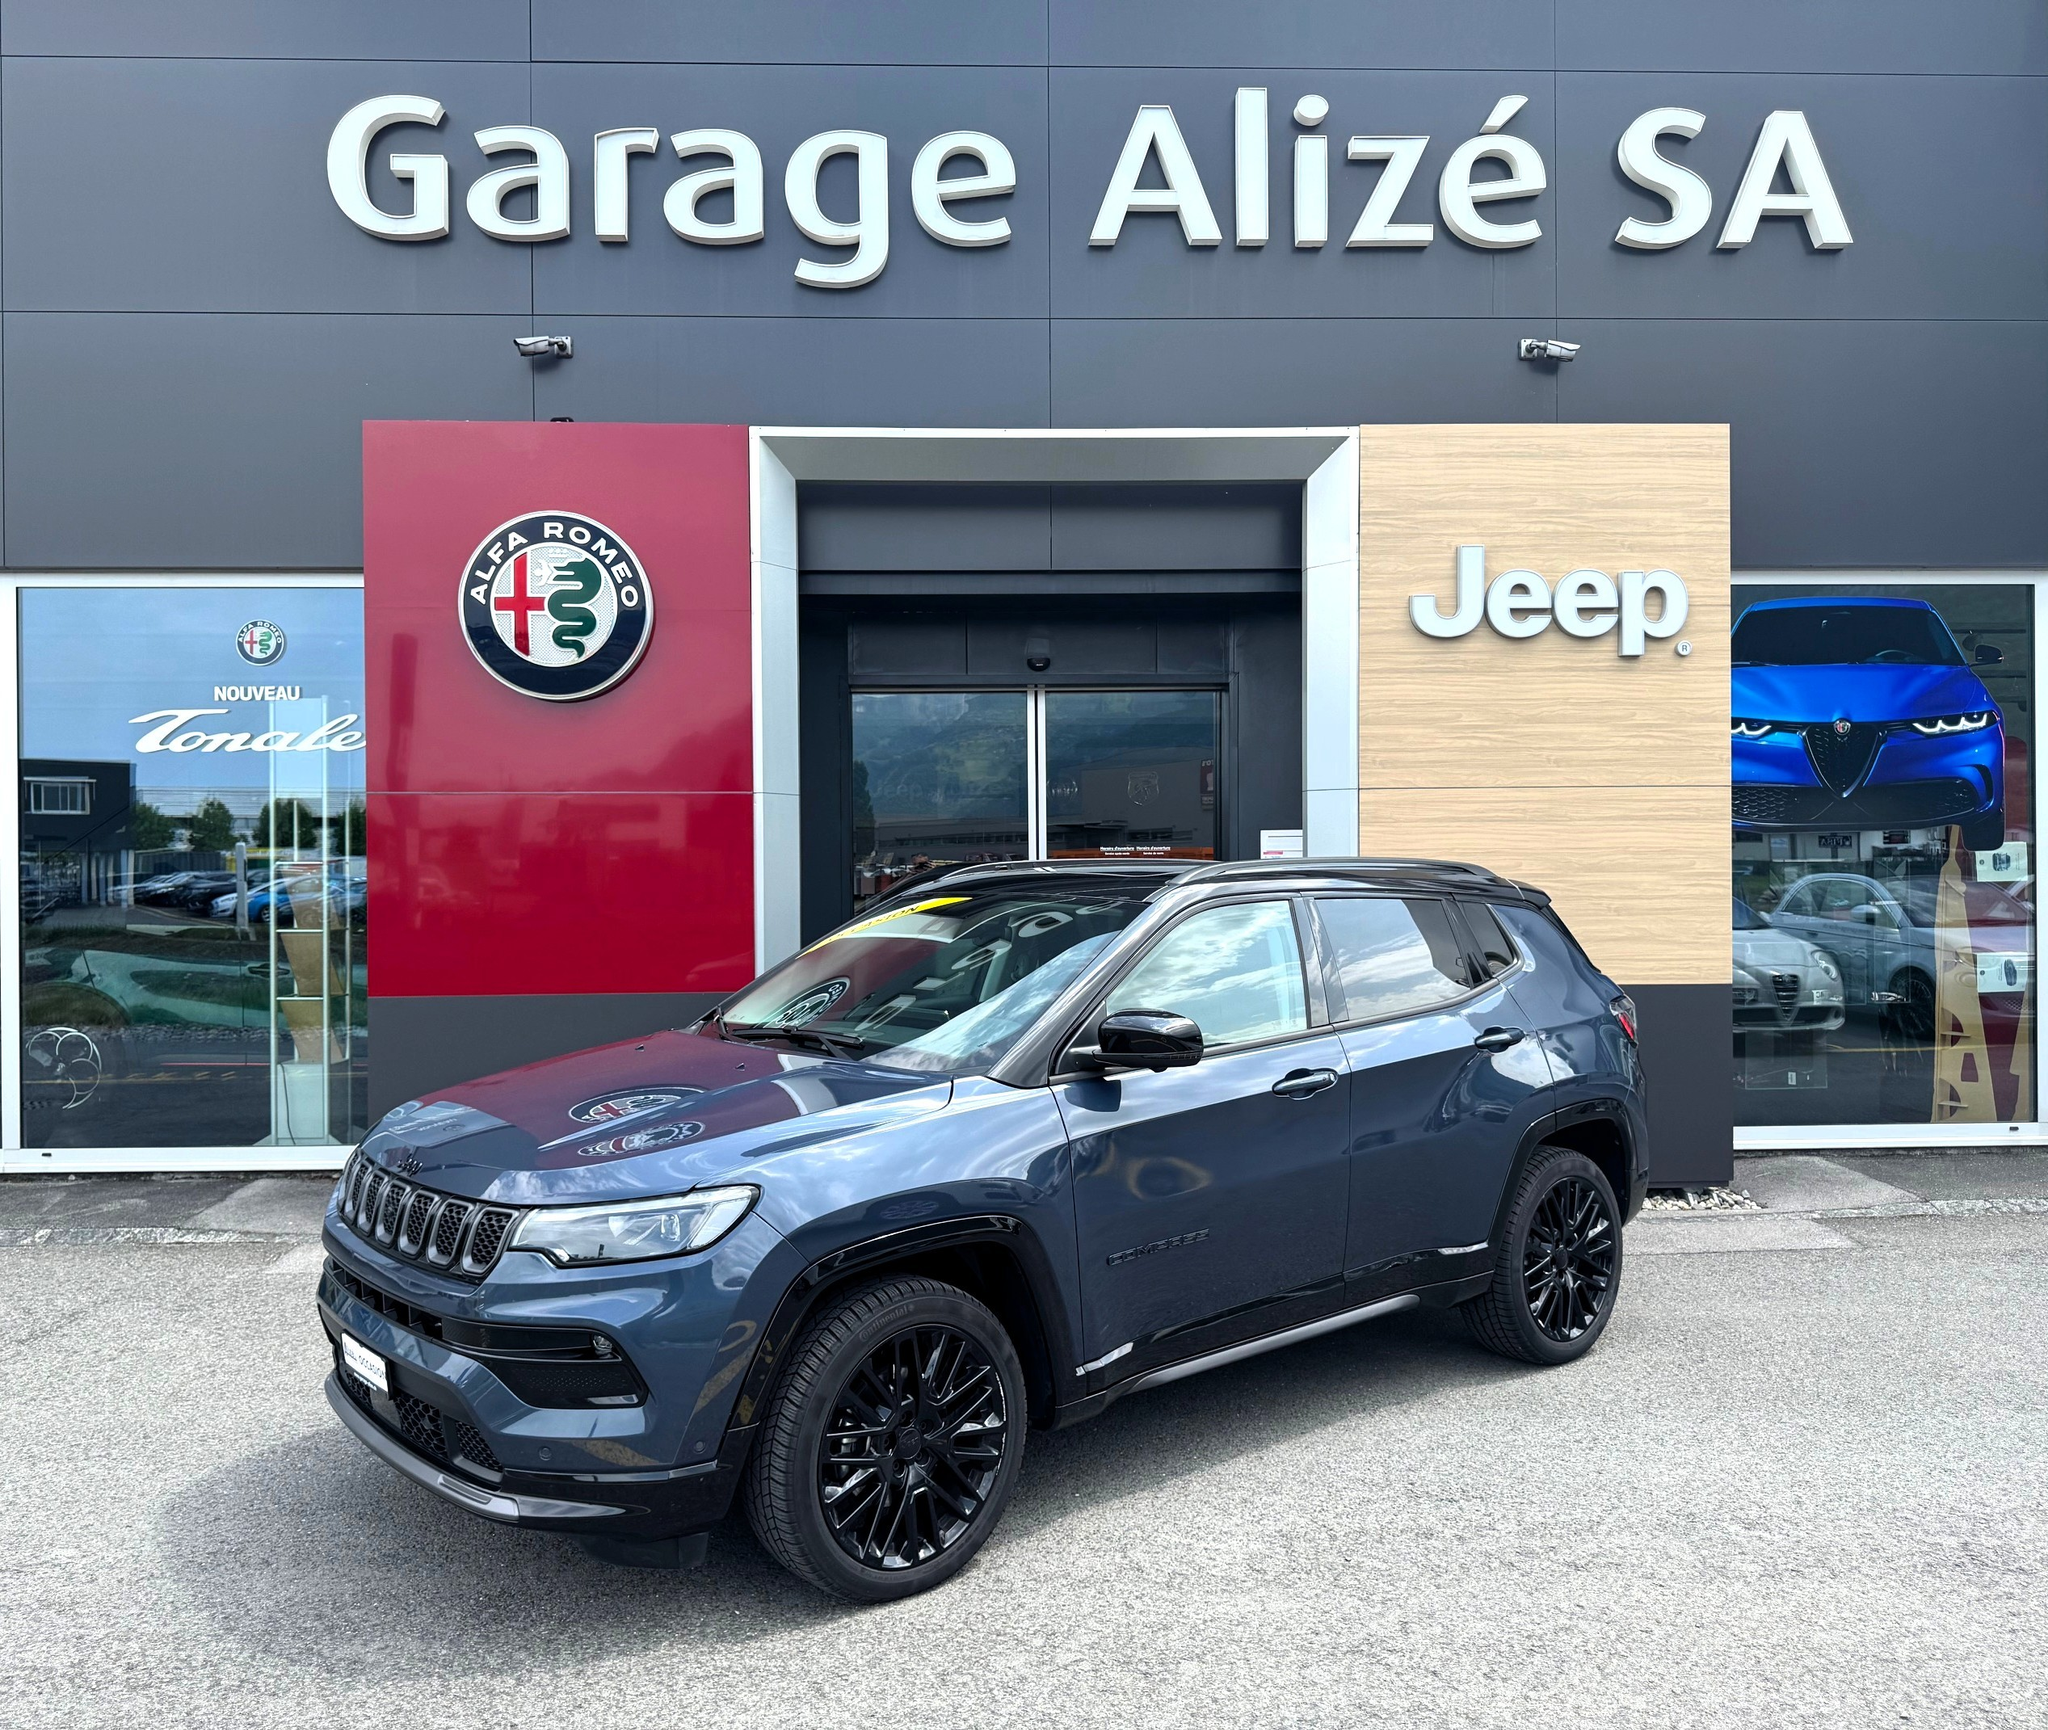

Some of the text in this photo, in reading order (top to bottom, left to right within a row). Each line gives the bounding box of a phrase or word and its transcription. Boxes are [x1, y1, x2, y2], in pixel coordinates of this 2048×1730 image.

[327, 87, 1854, 289] Garage Alizé SA
[470, 522, 639, 607] ALFA ROMEO
[238, 621, 282, 644] ALFA ROMEO
[1409, 544, 1689, 657] Jeep
[214, 685, 300, 701] NOUVEAU
[129, 708, 366, 753] Tonale
